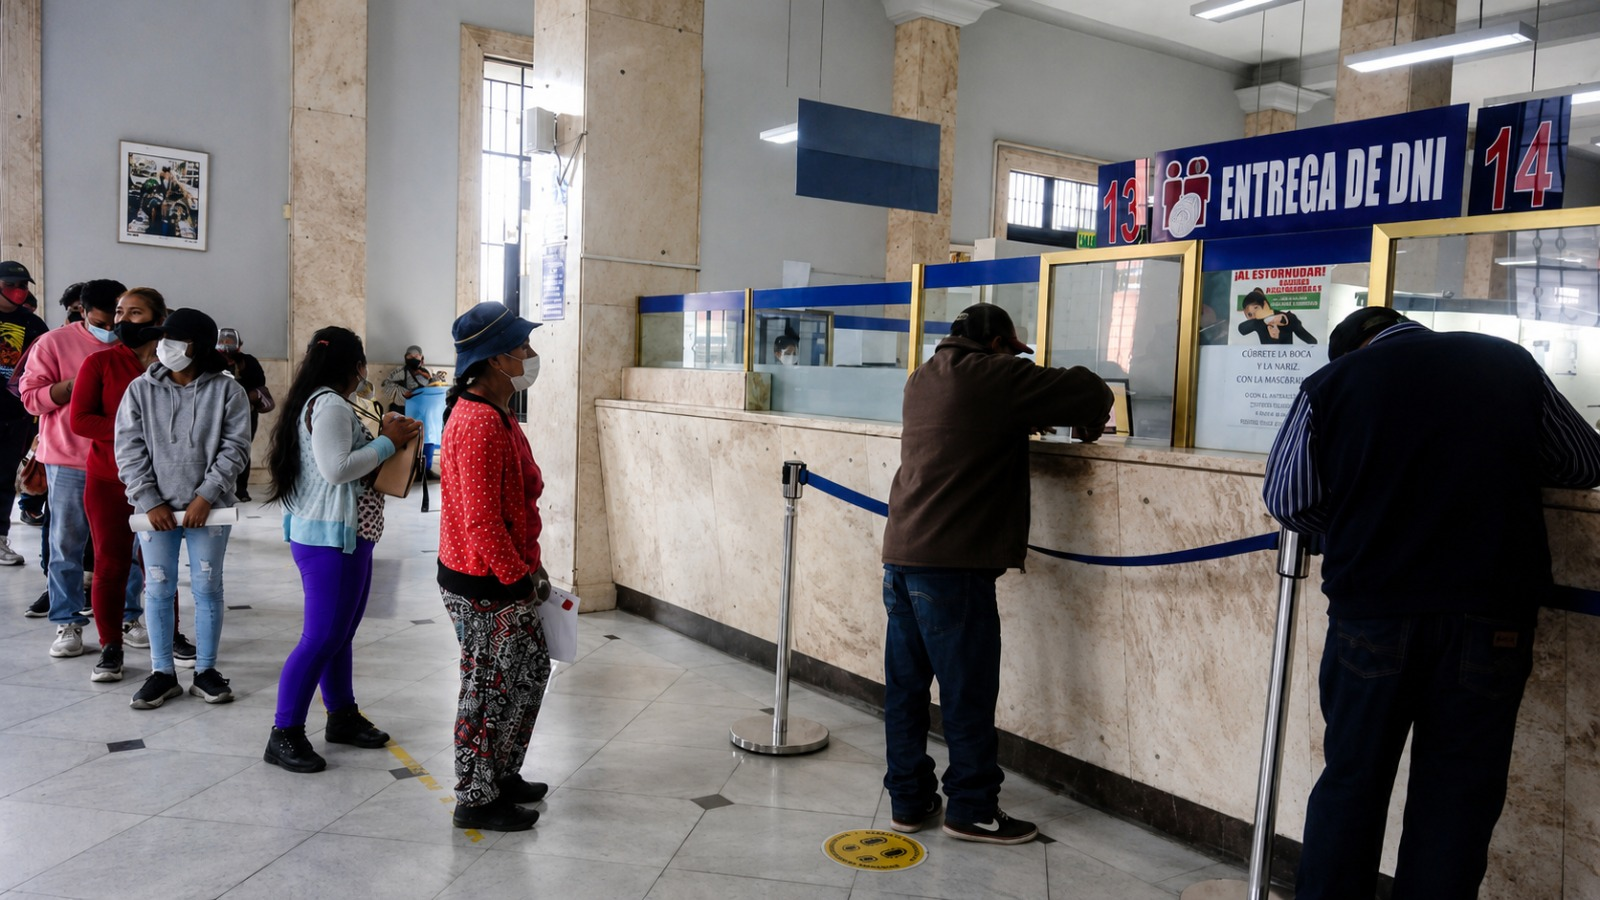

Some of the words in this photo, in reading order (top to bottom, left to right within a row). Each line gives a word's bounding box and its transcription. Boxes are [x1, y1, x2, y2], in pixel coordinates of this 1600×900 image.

[1220, 152, 1336, 221] ENTREGA
[1344, 145, 1383, 209] DE
[1388, 136, 1447, 205] DNI
[1485, 121, 1553, 211] 14
[1103, 177, 1141, 244] 13
[1234, 270, 1250, 281] ¡AL
[1252, 266, 1326, 280] ESTORNUDAR!
[1241, 349, 1276, 358] CÚBRETE
[1278, 350, 1288, 358] LA
[1289, 350, 1312, 358] BOCA
[1236, 375, 1253, 383] CON
